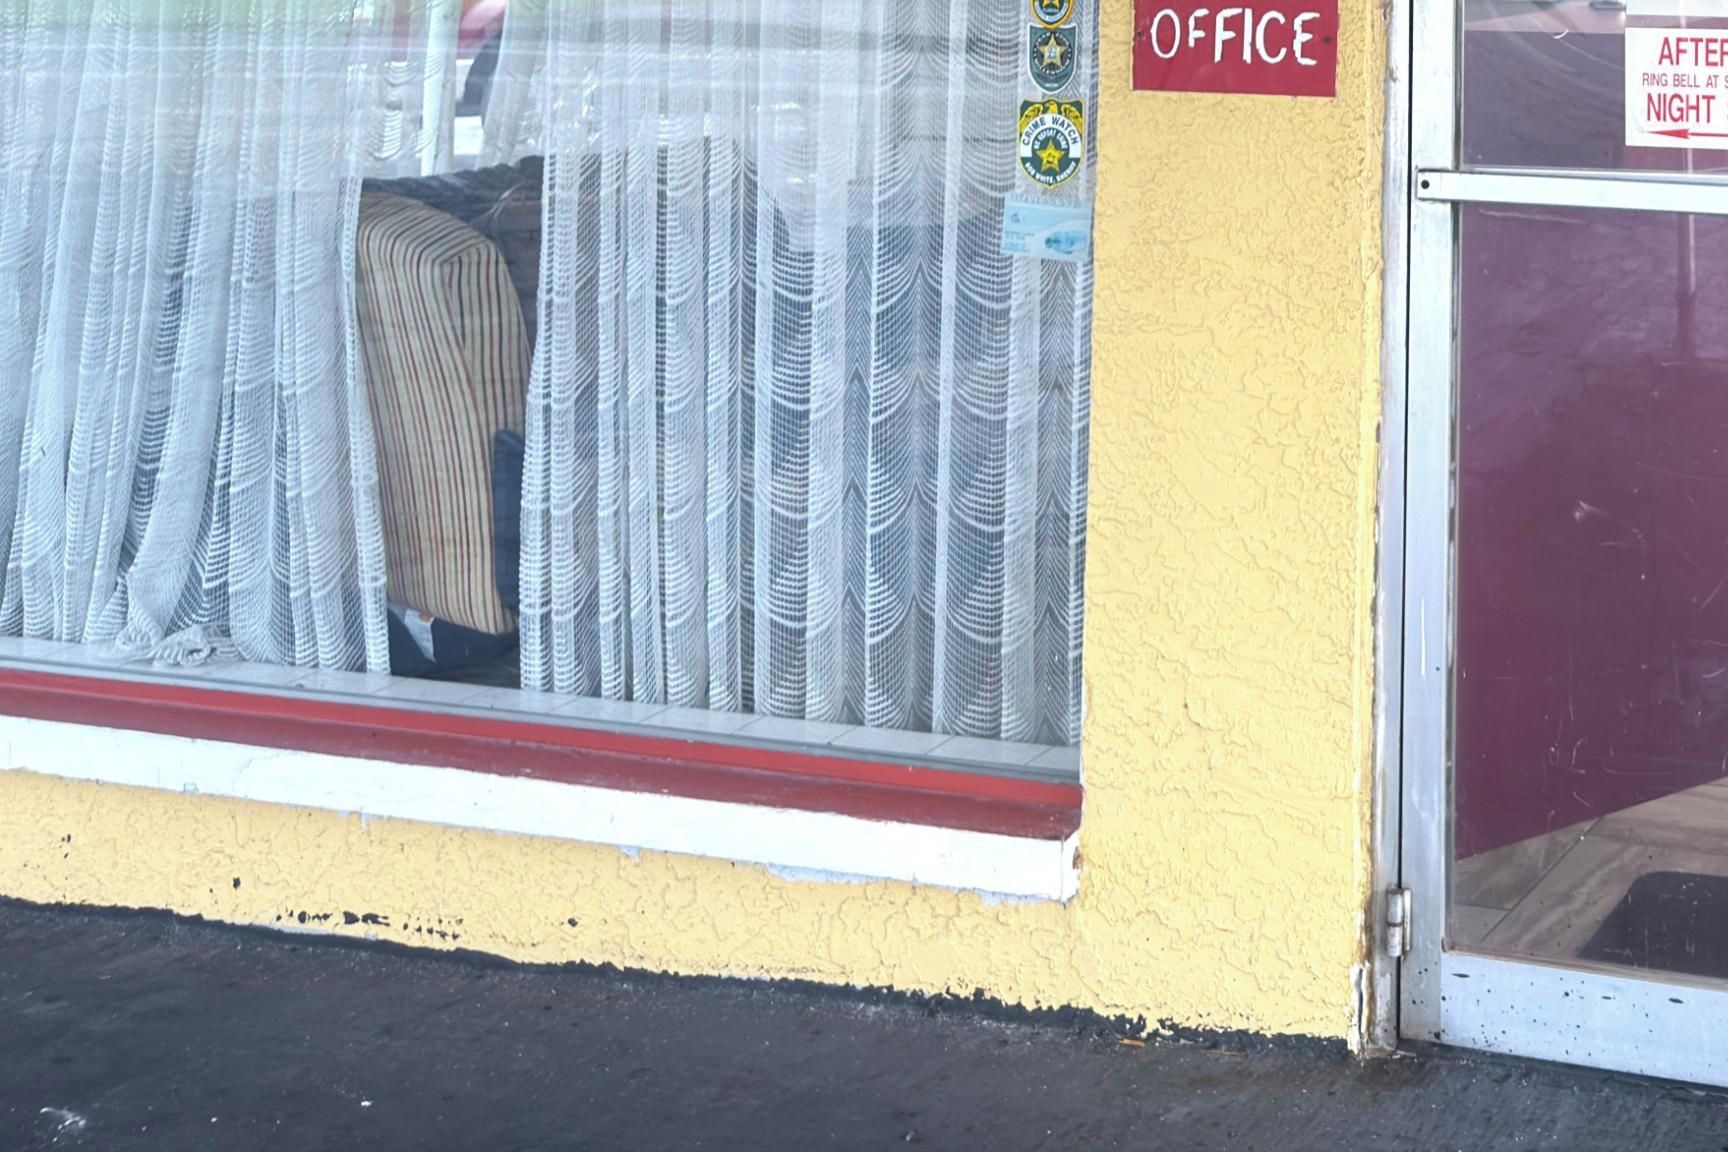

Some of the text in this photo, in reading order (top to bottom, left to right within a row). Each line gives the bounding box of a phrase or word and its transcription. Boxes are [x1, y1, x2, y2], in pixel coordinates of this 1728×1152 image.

[1150, 8, 1321, 66] OFFICE
[1642, 72, 1668, 87] RING
[1673, 74, 1700, 88] BELL
[1706, 74, 1719, 89] AT
[1647, 93, 1716, 124] NIGHT
[1022, 116, 1080, 146] CRIME WATCH
